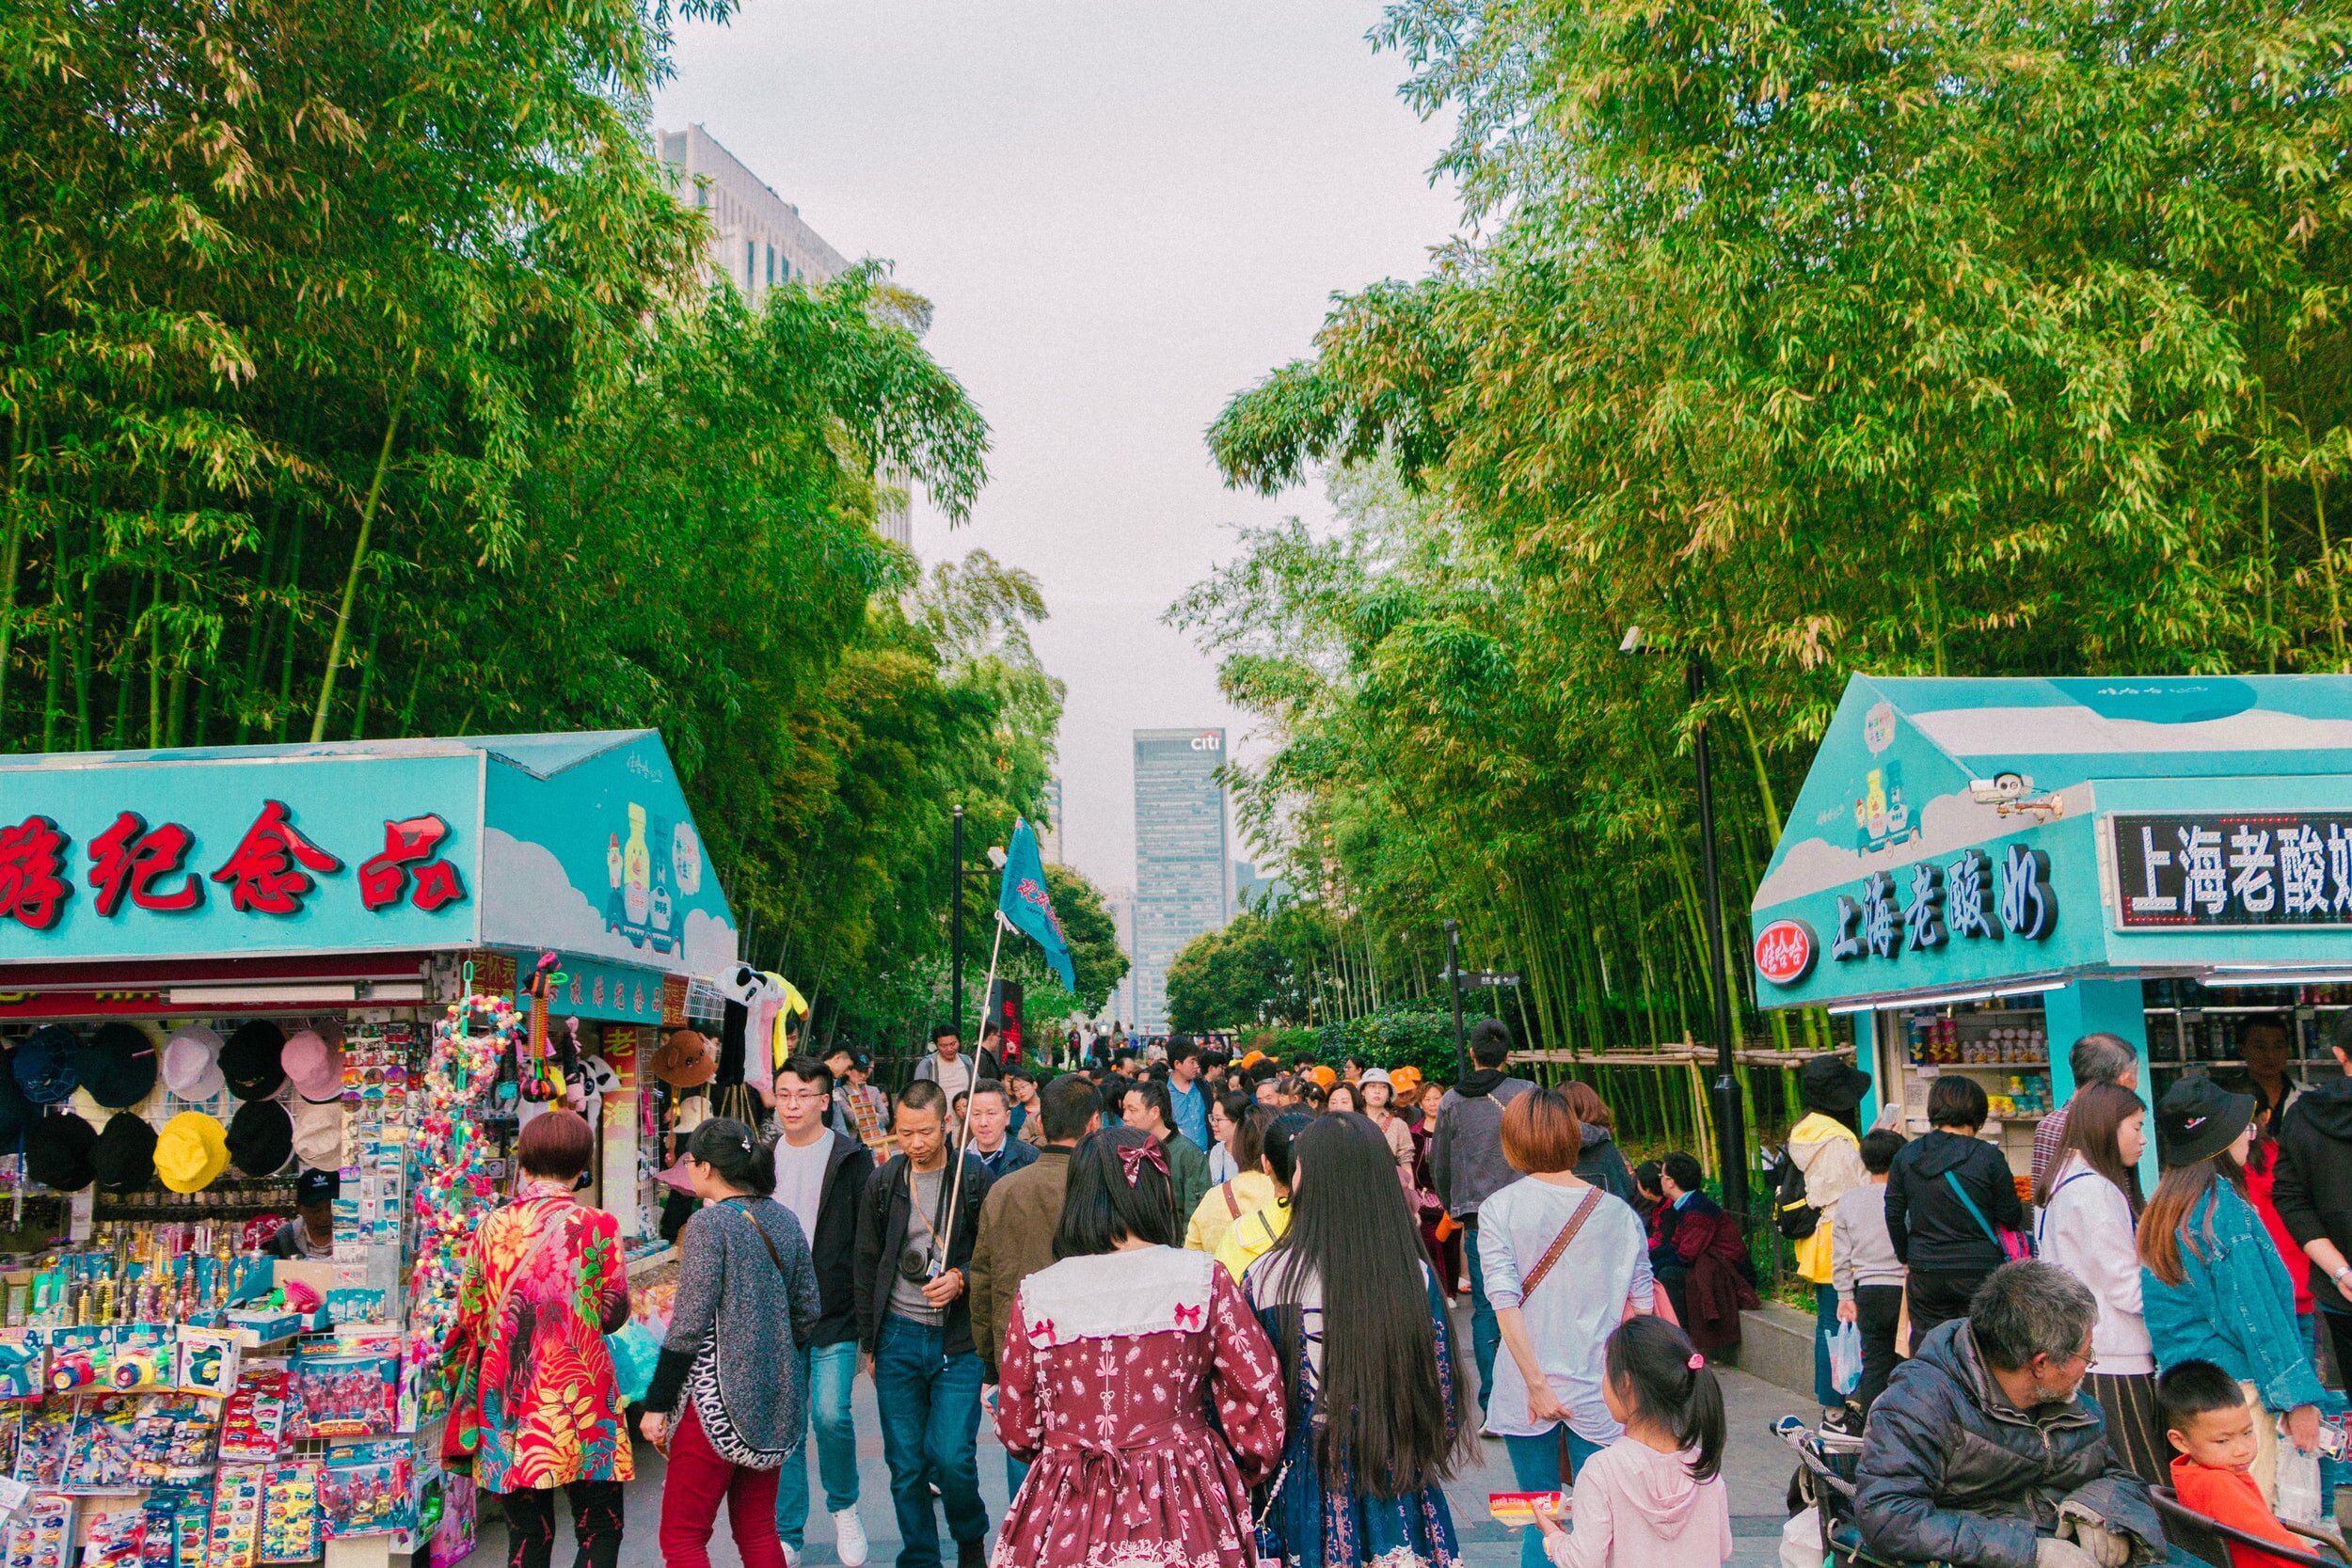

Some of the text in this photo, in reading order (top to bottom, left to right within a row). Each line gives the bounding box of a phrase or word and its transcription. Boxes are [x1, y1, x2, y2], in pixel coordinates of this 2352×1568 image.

[1191, 733, 1220, 751] citi
[1830, 843, 2051, 962] 上海老酸奶
